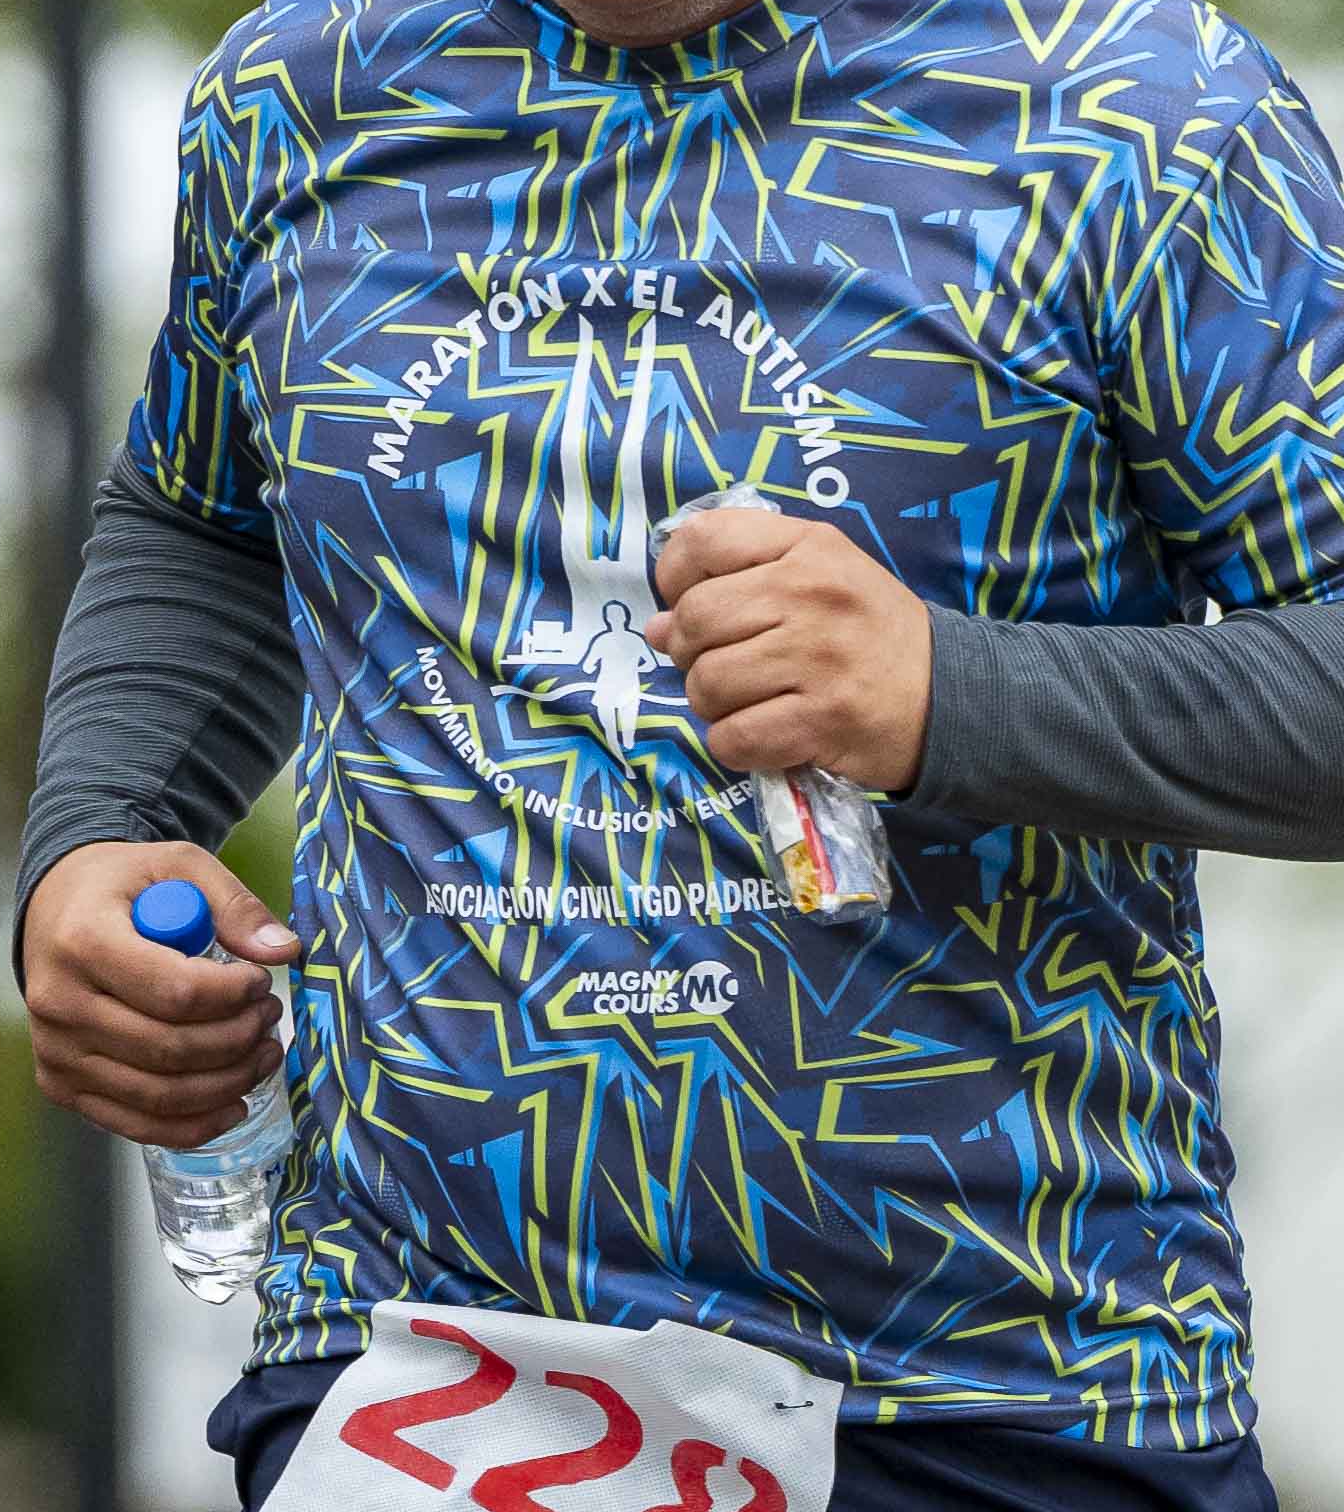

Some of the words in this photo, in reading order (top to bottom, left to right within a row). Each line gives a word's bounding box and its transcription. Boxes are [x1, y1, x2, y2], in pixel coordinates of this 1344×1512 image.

[367, 272, 566, 480] MARATÓN
[580, 267, 617, 307] X
[631, 268, 685, 318] EL
[695, 293, 850, 507] AUTISMO
[524, 789, 677, 833] INCLUSIÓN
[425, 876, 553, 919] ASOCIACIÓN
[561, 886, 627, 920] CIVIL
[628, 884, 682, 919] TGD
[575, 969, 682, 993] MAGNY
[592, 991, 680, 1015] COURS
